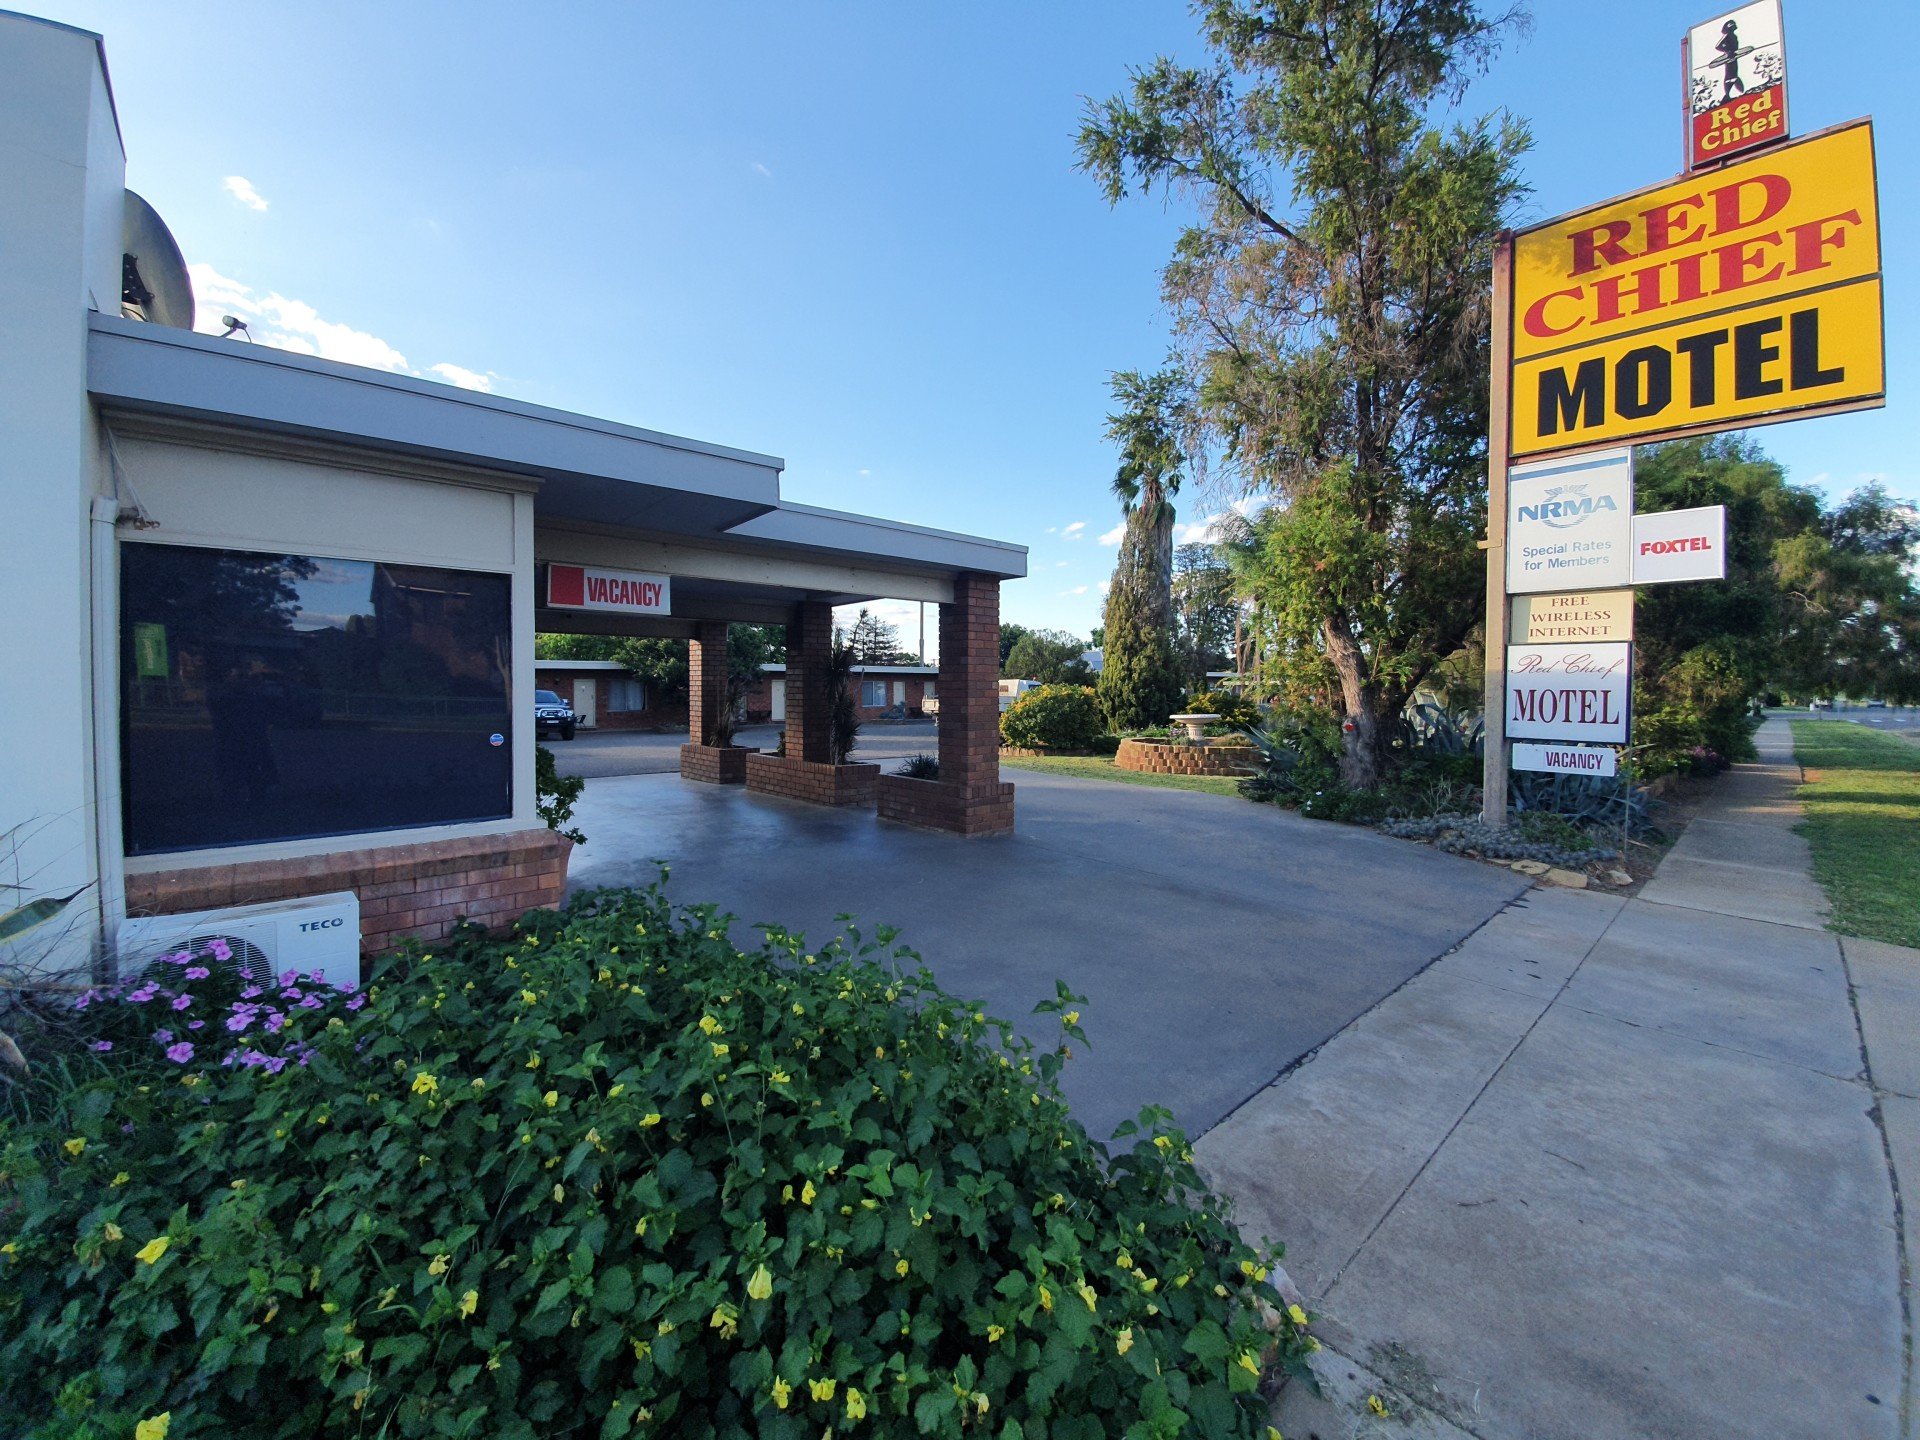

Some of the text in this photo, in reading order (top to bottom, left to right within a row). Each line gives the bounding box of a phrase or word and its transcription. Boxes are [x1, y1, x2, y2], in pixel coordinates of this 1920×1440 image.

[1710, 90, 1772, 129] Red
[1701, 110, 1781, 151] Chief
[1566, 174, 1791, 279] RED
[1523, 208, 1862, 338] CHIEF
[1537, 307, 1845, 438] MOTEL
[1518, 495, 1617, 522] NRMA
[1522, 540, 1611, 558] Special Rates
[1640, 536, 1712, 556] FOXTEL
[1524, 556, 1609, 570] for Members
[587, 577, 662, 606] VACANCY
[1551, 596, 1590, 607] FREE
[1531, 610, 1611, 622] WIRELESS
[1529, 625, 1612, 637] INTERNET
[1511, 653, 1625, 679] Red Chief
[1512, 689, 1619, 724] MOTEL
[1545, 752, 1604, 770] VACANCY
[299, 918, 343, 932] TECO
